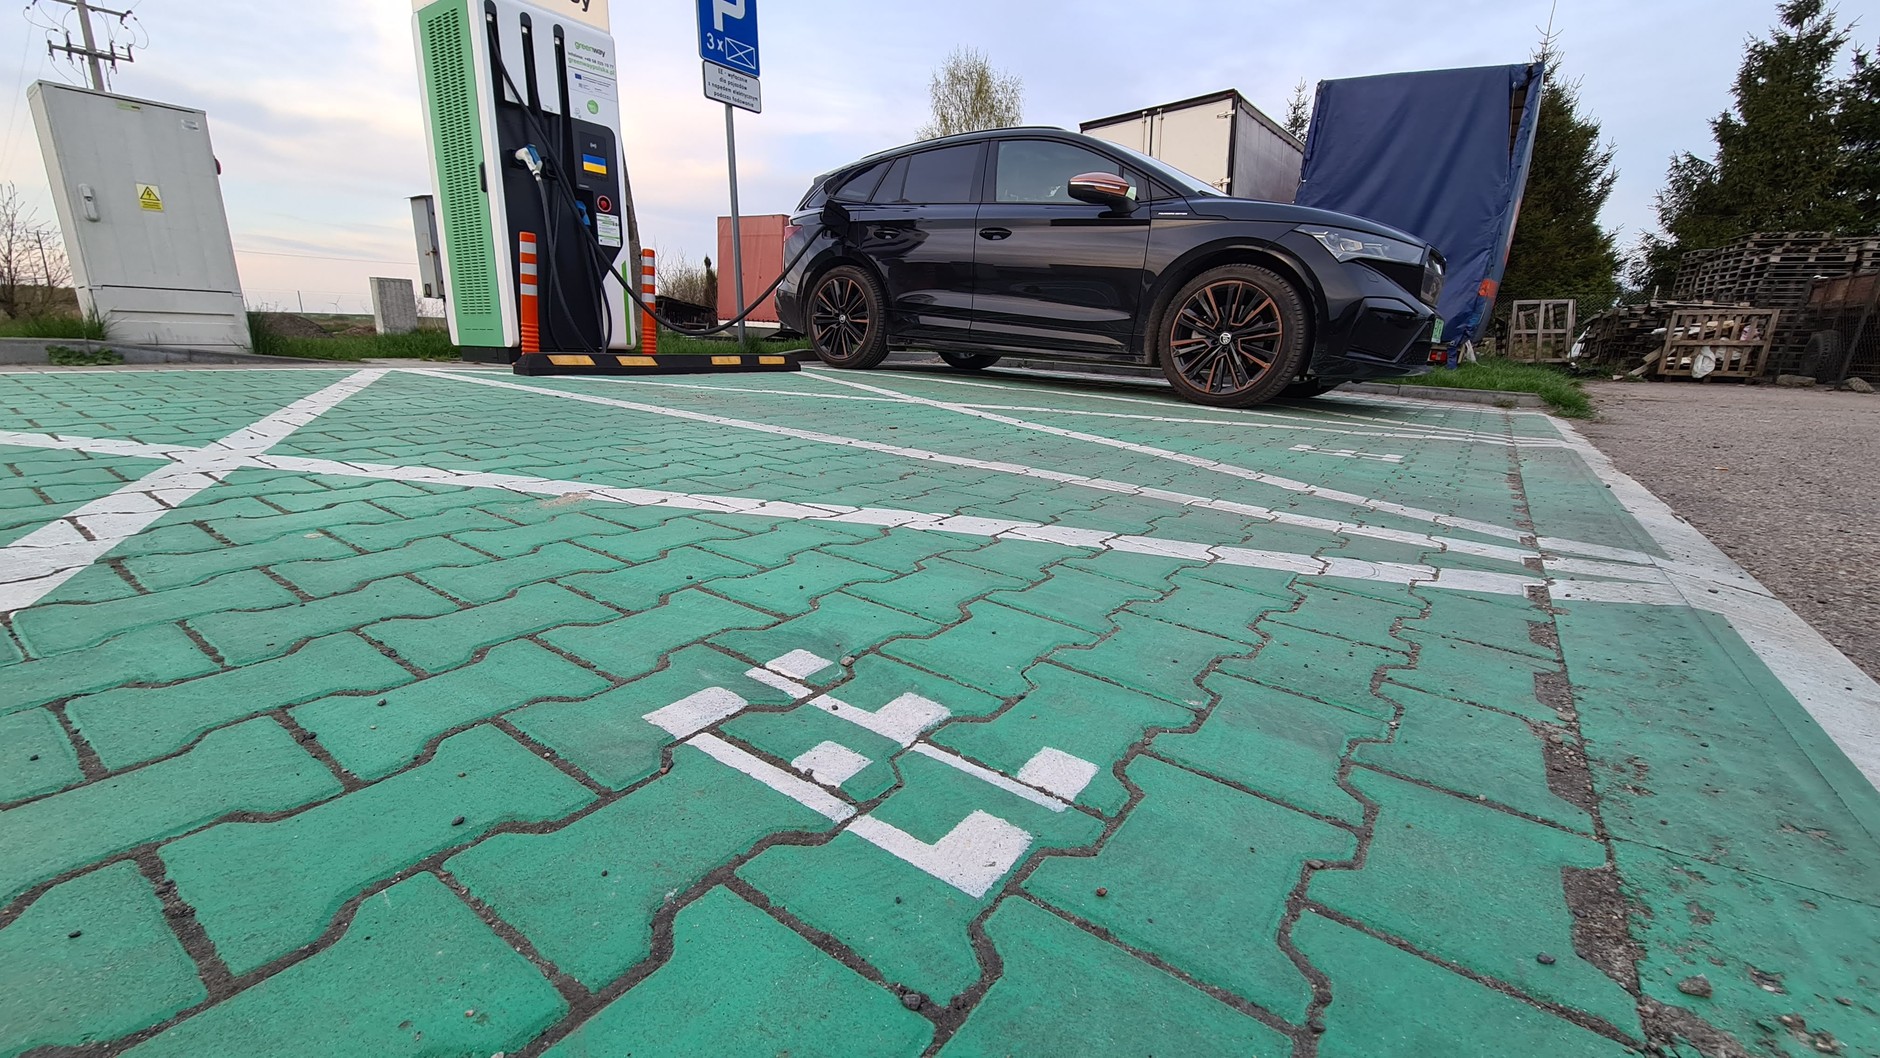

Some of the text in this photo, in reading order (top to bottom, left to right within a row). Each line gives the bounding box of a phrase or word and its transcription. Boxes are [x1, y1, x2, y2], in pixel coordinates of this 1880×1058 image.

[574, 41, 606, 58] greenway
[706, 32, 724, 52] 3 x
